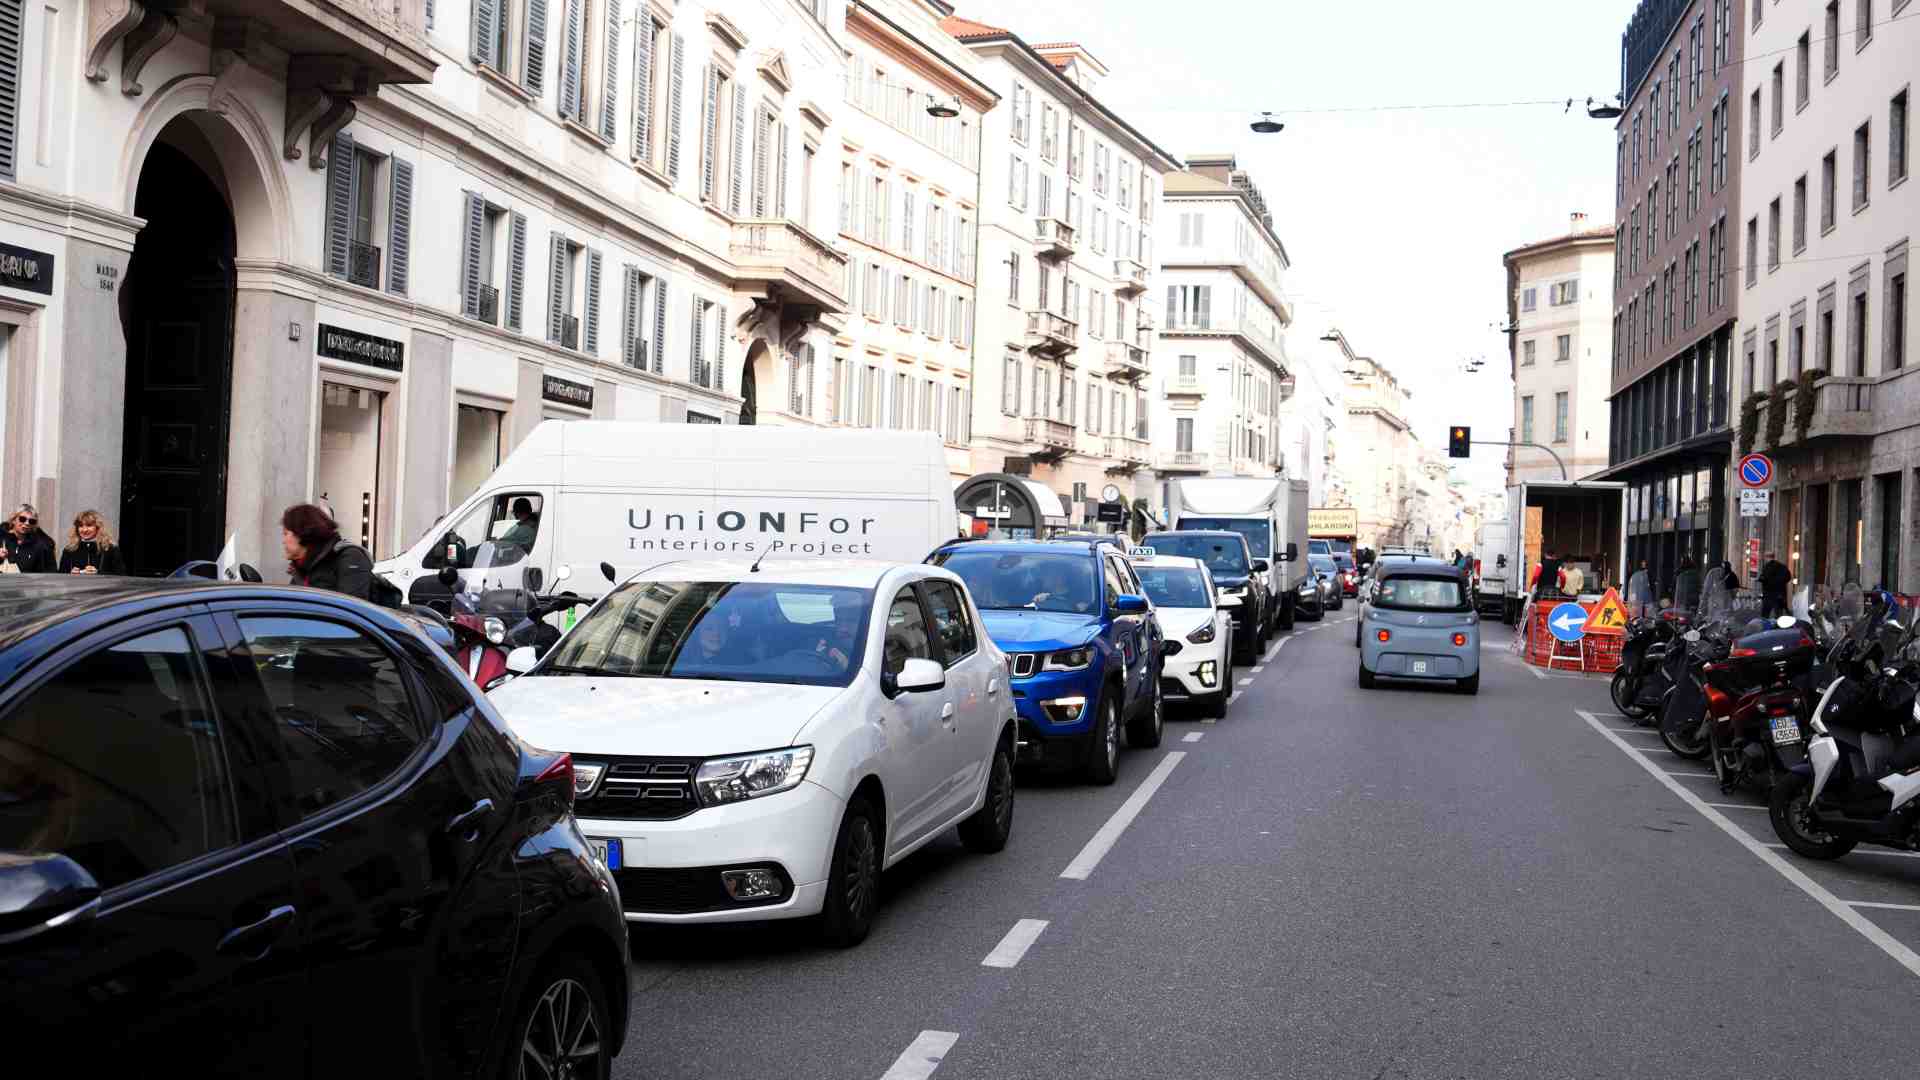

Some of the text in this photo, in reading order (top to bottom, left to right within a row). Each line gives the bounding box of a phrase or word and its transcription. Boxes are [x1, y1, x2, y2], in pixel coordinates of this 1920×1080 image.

[627, 508, 876, 535] UniONFor
[628, 536, 873, 556] Interiors Project
[1128, 547, 1153, 556] TAXI
